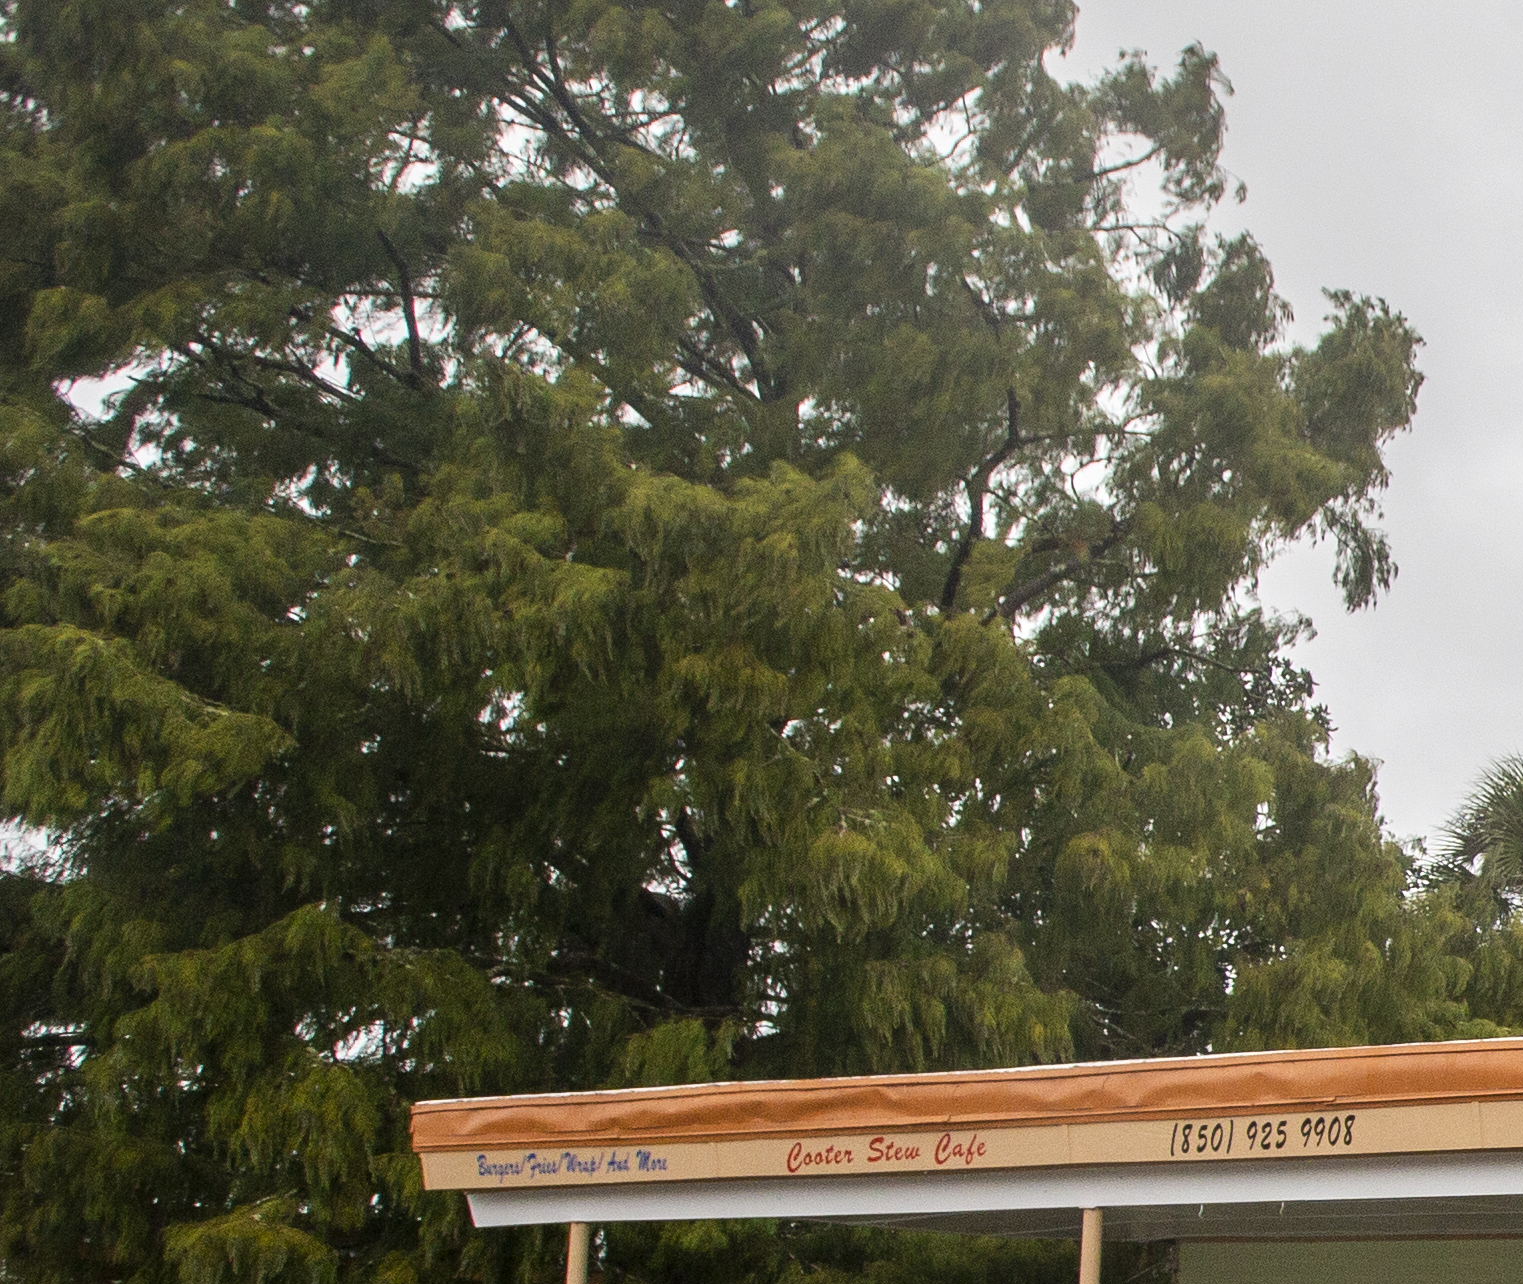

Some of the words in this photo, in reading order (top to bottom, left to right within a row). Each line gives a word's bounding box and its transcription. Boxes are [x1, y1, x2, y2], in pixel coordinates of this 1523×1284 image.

[786, 1142, 853, 1173] Cooter
[867, 1136, 921, 1162] Stew
[934, 1133, 987, 1165] Cafe
[1170, 1119, 1234, 1157] (850)
[1246, 1120, 1288, 1150] 925
[1300, 1114, 1356, 1147] 9908
[605, 1150, 630, 1174] And
[636, 1149, 668, 1172] More
